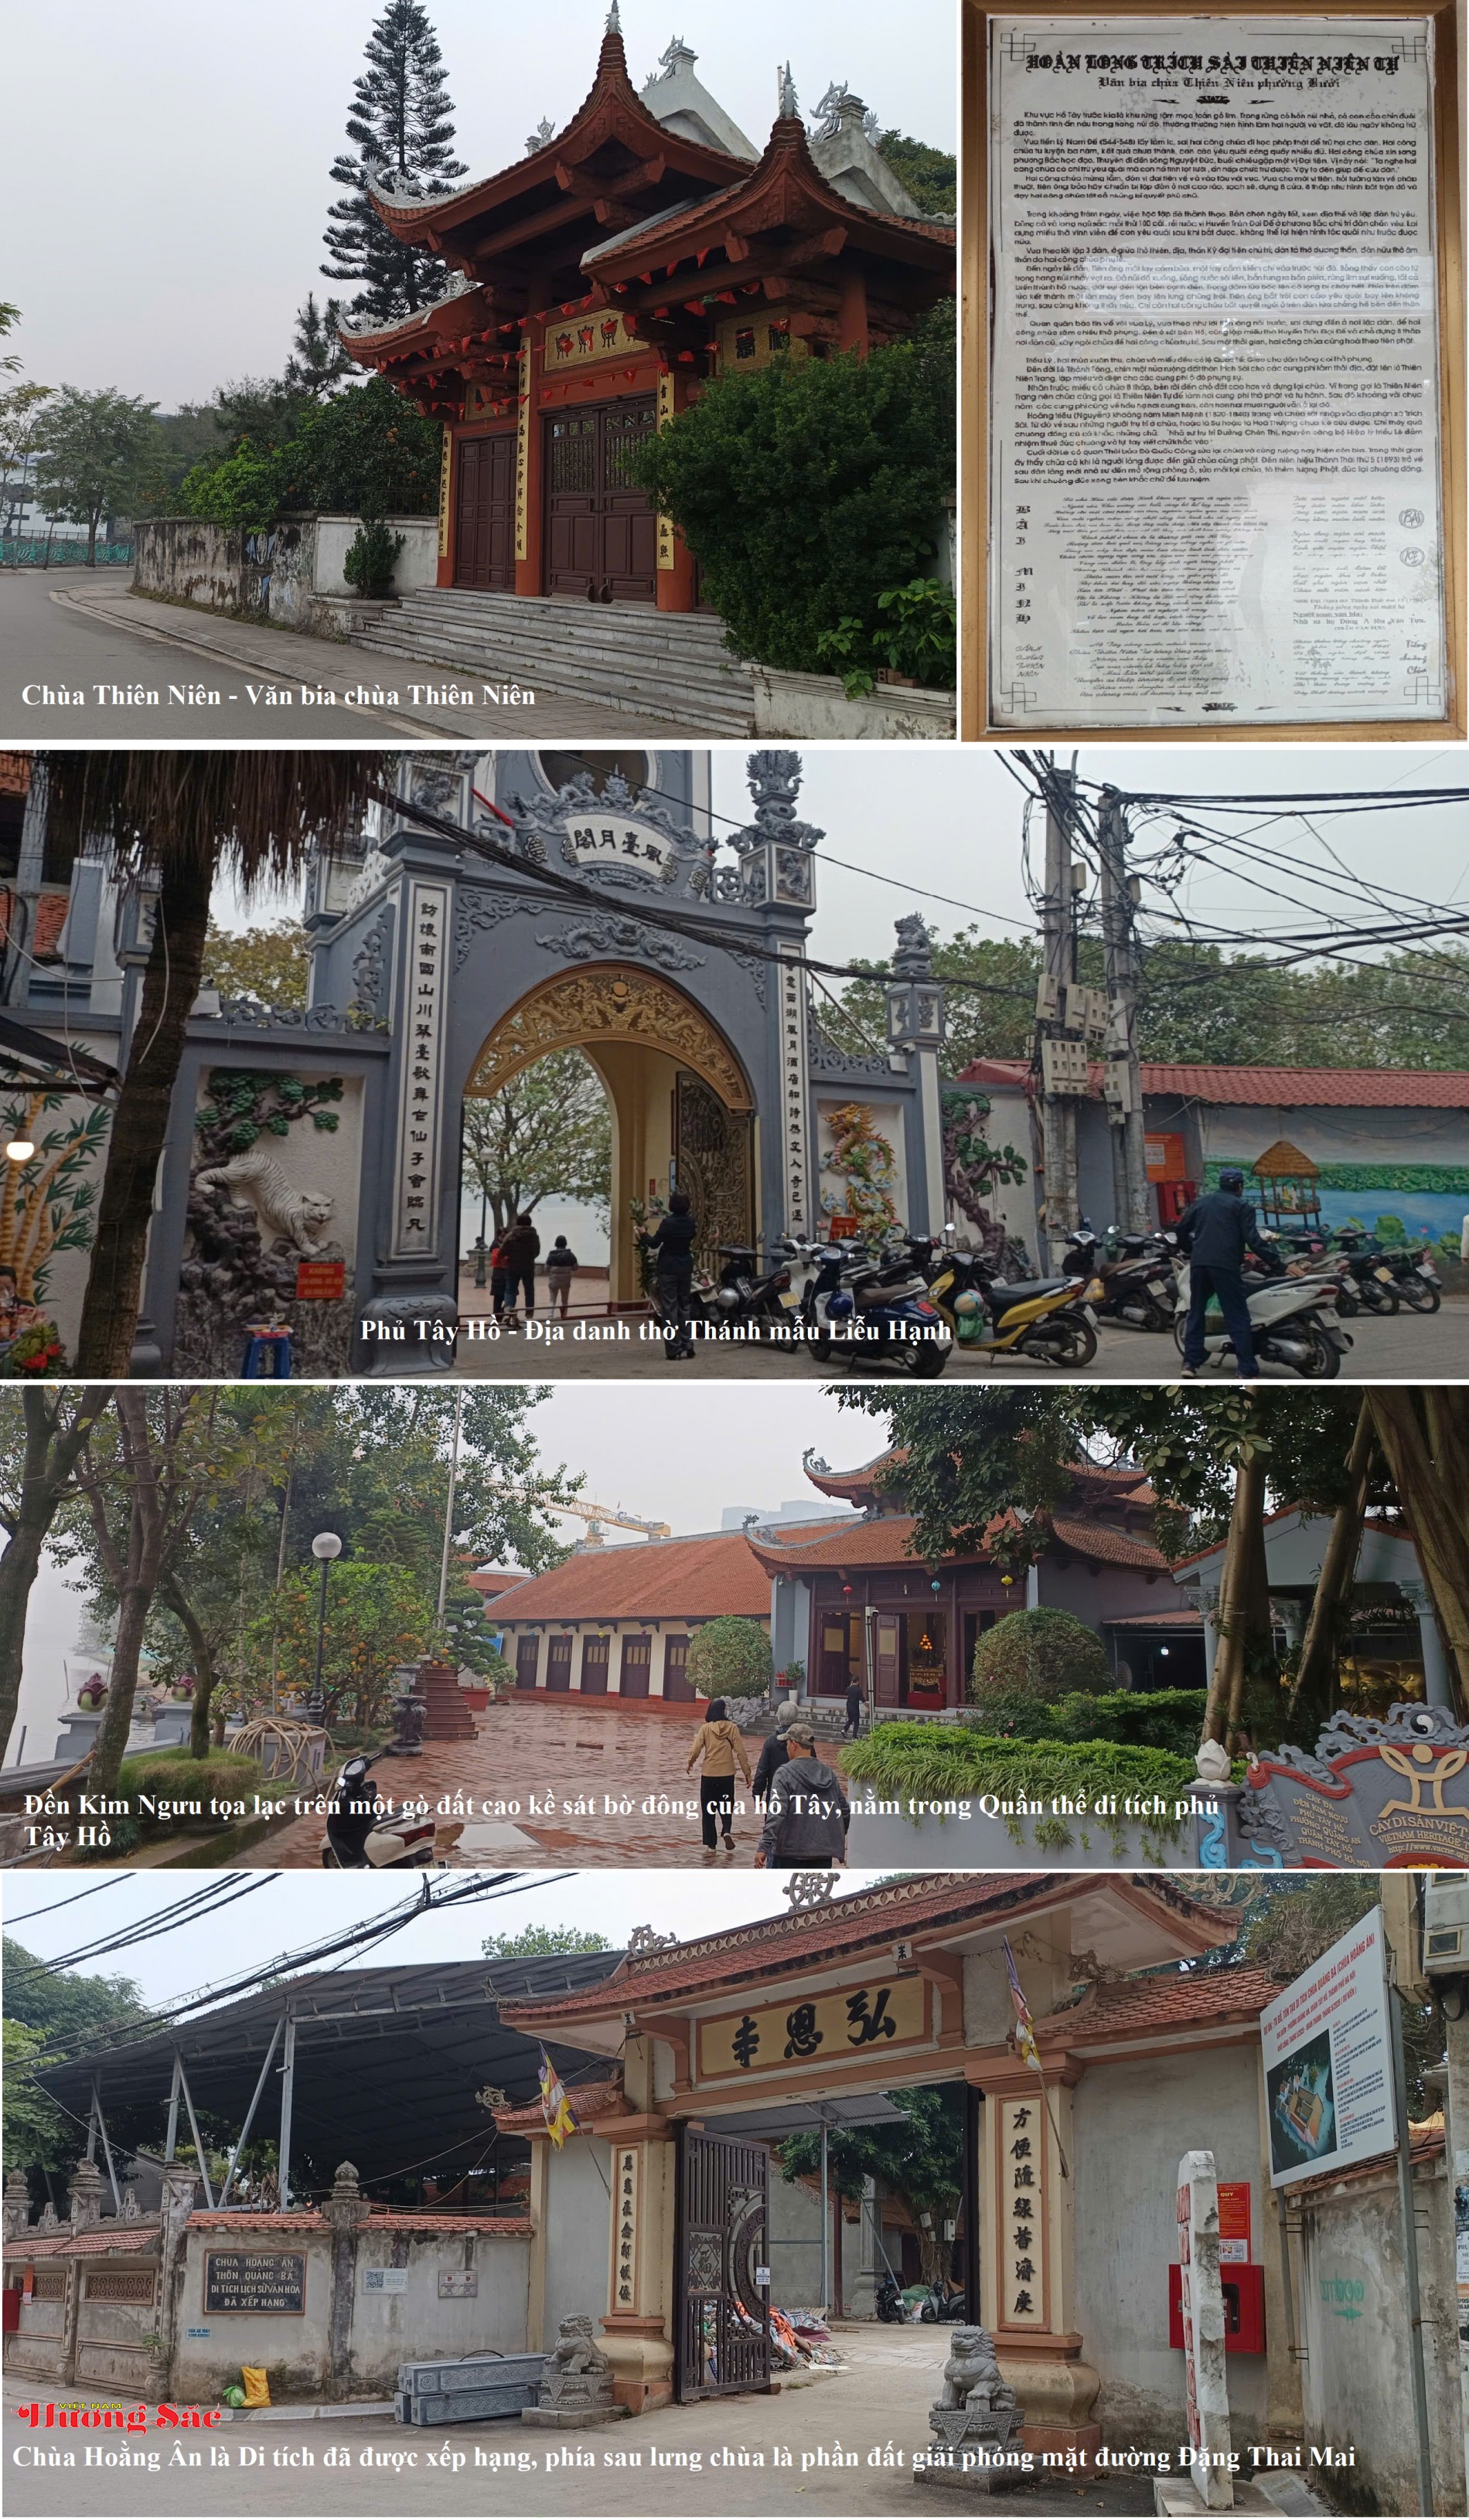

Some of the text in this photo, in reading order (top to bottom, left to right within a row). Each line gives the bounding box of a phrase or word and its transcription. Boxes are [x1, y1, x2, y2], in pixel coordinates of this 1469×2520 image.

[1085, 54, 1138, 73] LONG
[1205, 52, 1247, 74] SÀI
[1251, 52, 1314, 74] THIÊN
[1317, 53, 1370, 75] NIÊN
[1129, 77, 1147, 87] bia
[1151, 77, 1178, 90] chùa
[1184, 77, 1219, 90] Thiên
[1223, 77, 1254, 90] Niên
[1258, 78, 1303, 90] phường
[1305, 1793, 1335, 1810] CÂY ĐA
[1311, 1804, 1327, 1816] KIM
[1317, 1816, 1331, 1827] TÂY
[1369, 1814, 1468, 1837] CÂY DI SẢN VIỆT
[1324, 1837, 1340, 1848] TÂY
[1378, 1830, 1461, 1846] VIETNAM HERITAGE
[216, 2256, 238, 2266] CHÙA
[216, 2270, 238, 2280] THÔN
[245, 2269, 274, 2280] QUẢNG
[211, 2285, 219, 2294] DI
[221, 2283, 238, 2294] TÍCH
[240, 2285, 256, 2295] LỊCH
[268, 2283, 284, 2294] VĂN
[224, 2294, 285, 2307] ĐÃ XẾP HẠNG
